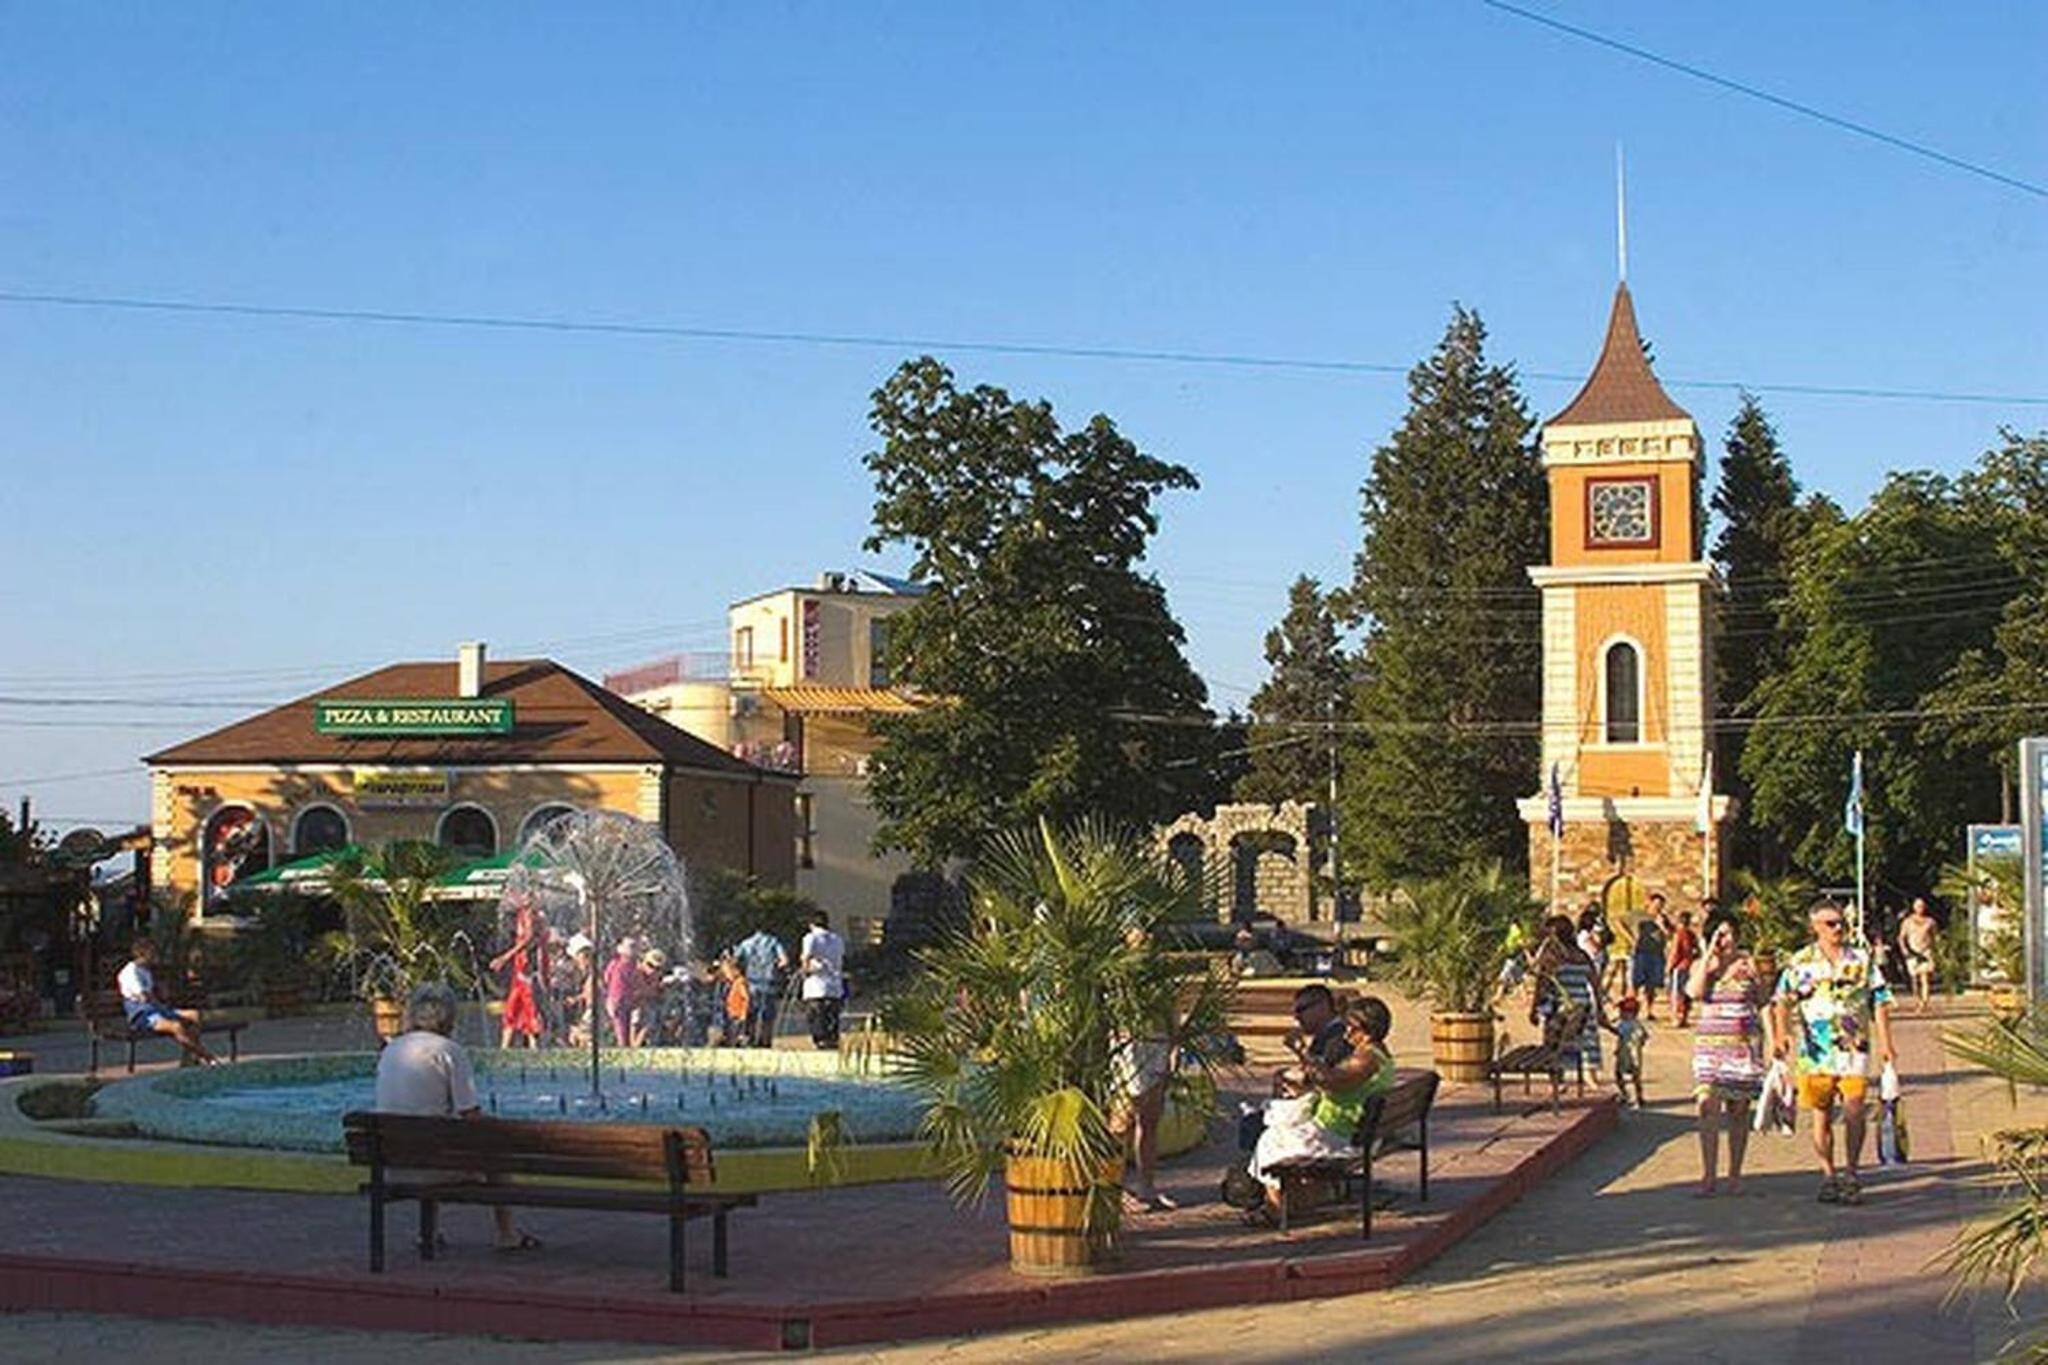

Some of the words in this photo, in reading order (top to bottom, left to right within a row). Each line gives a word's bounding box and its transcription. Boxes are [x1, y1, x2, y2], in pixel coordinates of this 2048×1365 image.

[325, 709, 371, 723] PIZZA
[375, 709, 388, 723] &
[393, 709, 502, 723] RESTAURANT
